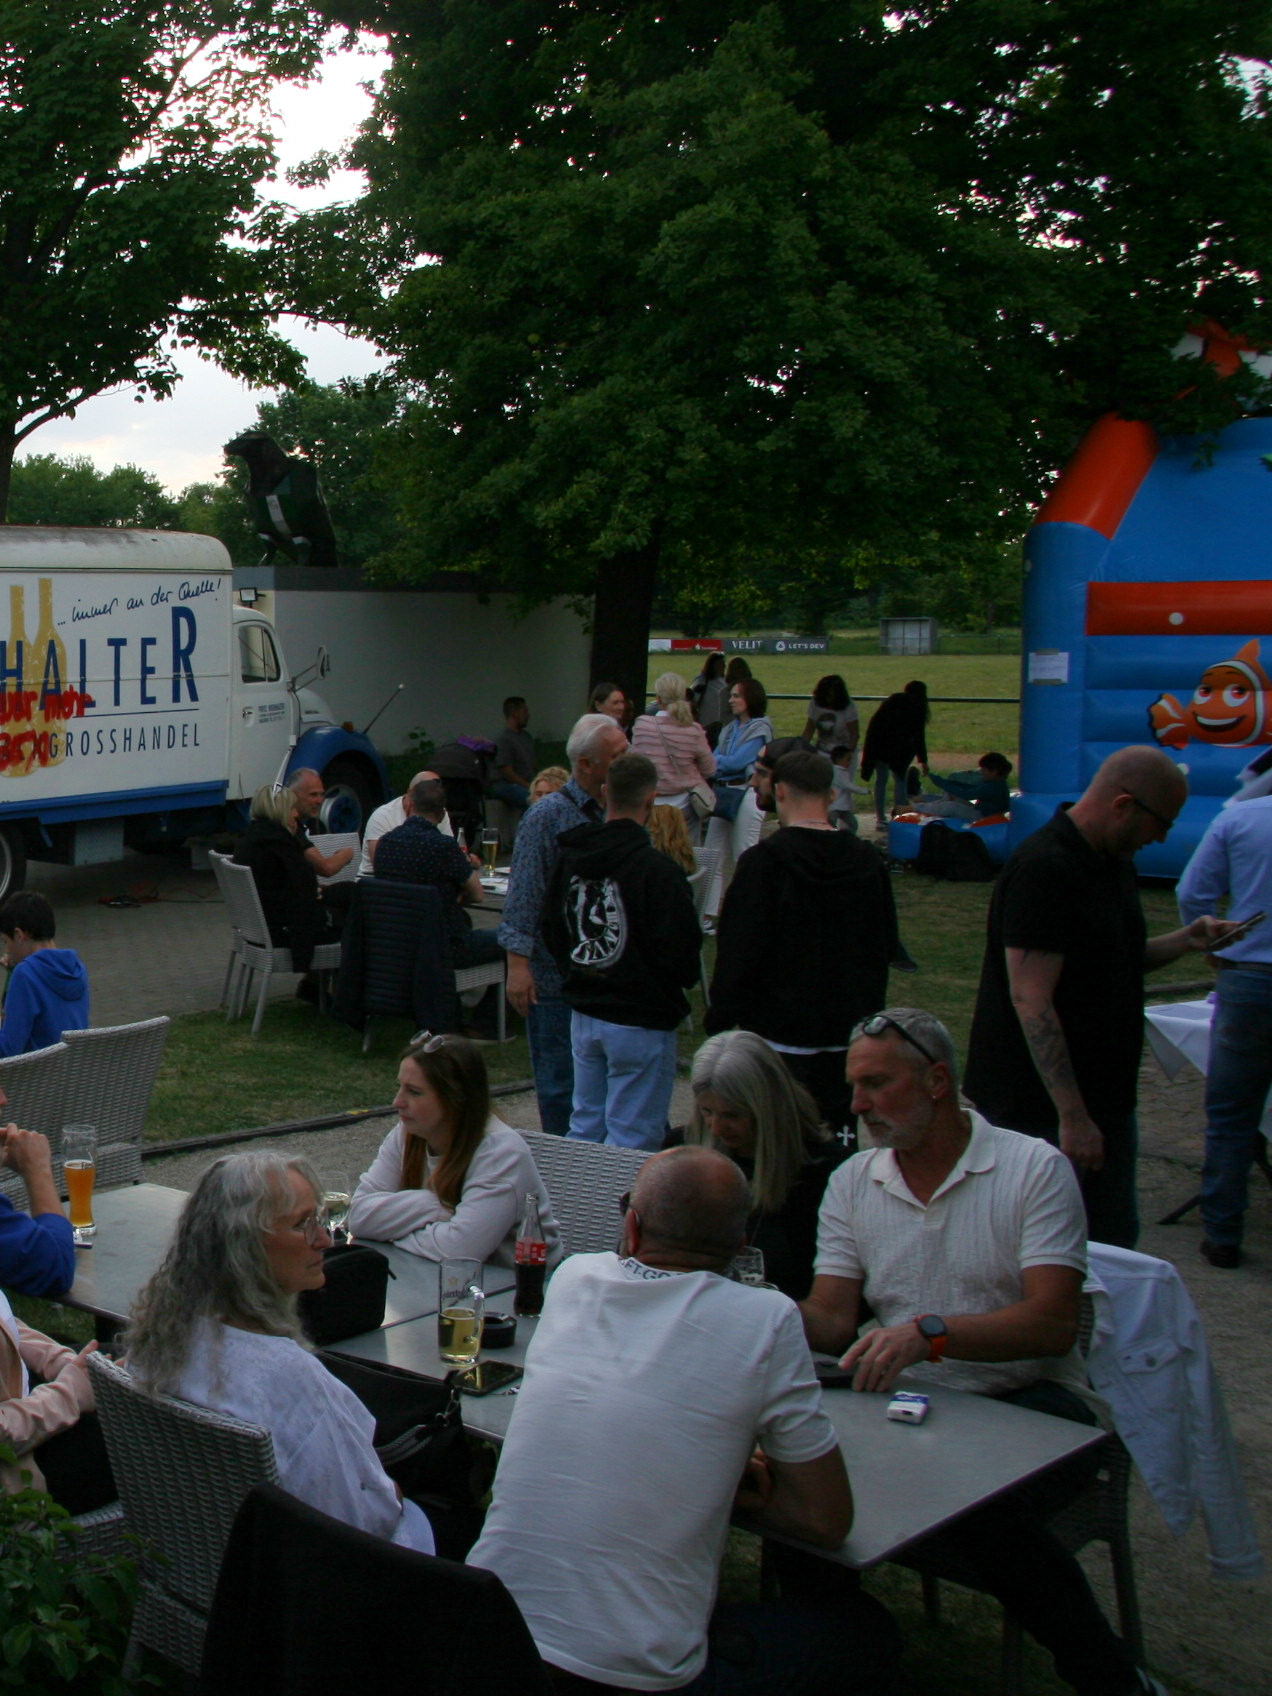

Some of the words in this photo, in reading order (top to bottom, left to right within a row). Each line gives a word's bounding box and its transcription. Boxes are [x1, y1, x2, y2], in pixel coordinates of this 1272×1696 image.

[72, 598, 119, 623] immer
[127, 598, 144, 610] an
[150, 585, 173, 606] der
[178, 578, 222, 601] Quelle!
